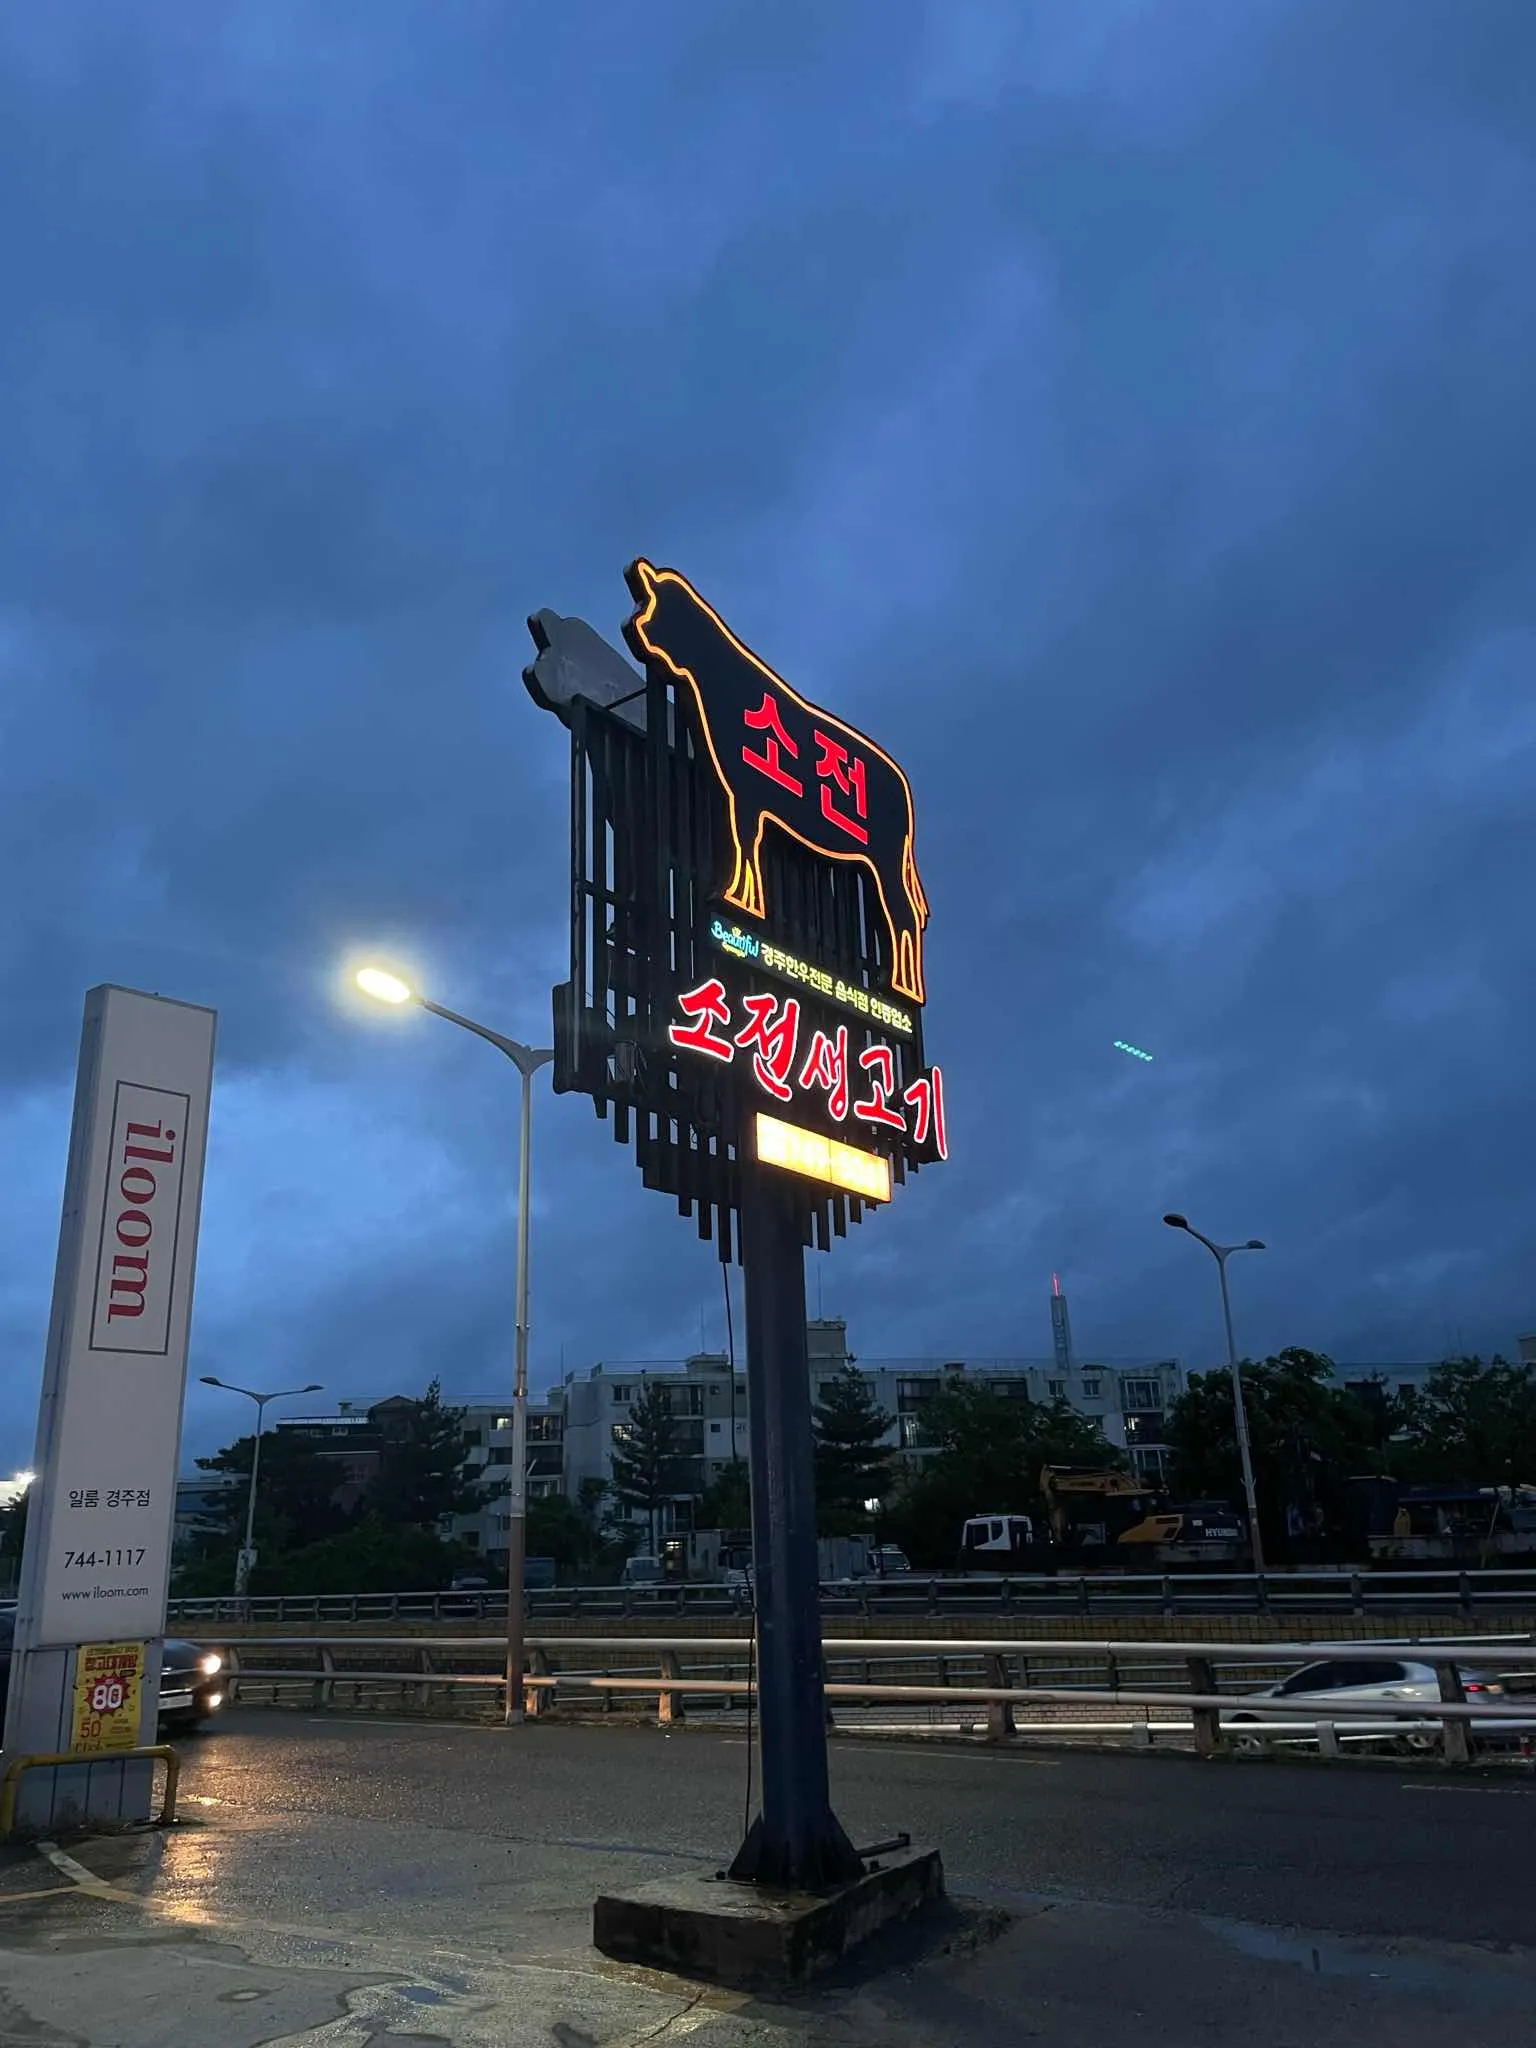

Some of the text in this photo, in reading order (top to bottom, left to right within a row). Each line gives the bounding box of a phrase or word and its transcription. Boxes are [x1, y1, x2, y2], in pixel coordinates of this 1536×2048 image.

[742, 693, 867, 844] 소전
[710, 920, 759, 957] Beautiful
[761, 943, 833, 996] 경주한우전문
[835, 980, 869, 1013] 음식점
[669, 978, 948, 1160] 소전생고기
[108, 1120, 176, 1324] iloom
[69, 1488, 150, 1508] 일룸 경주점
[64, 1549, 146, 1569] 744-1117
[62, 1586, 149, 1600] wwwiloom.com
[92, 1684, 122, 1710] 80
